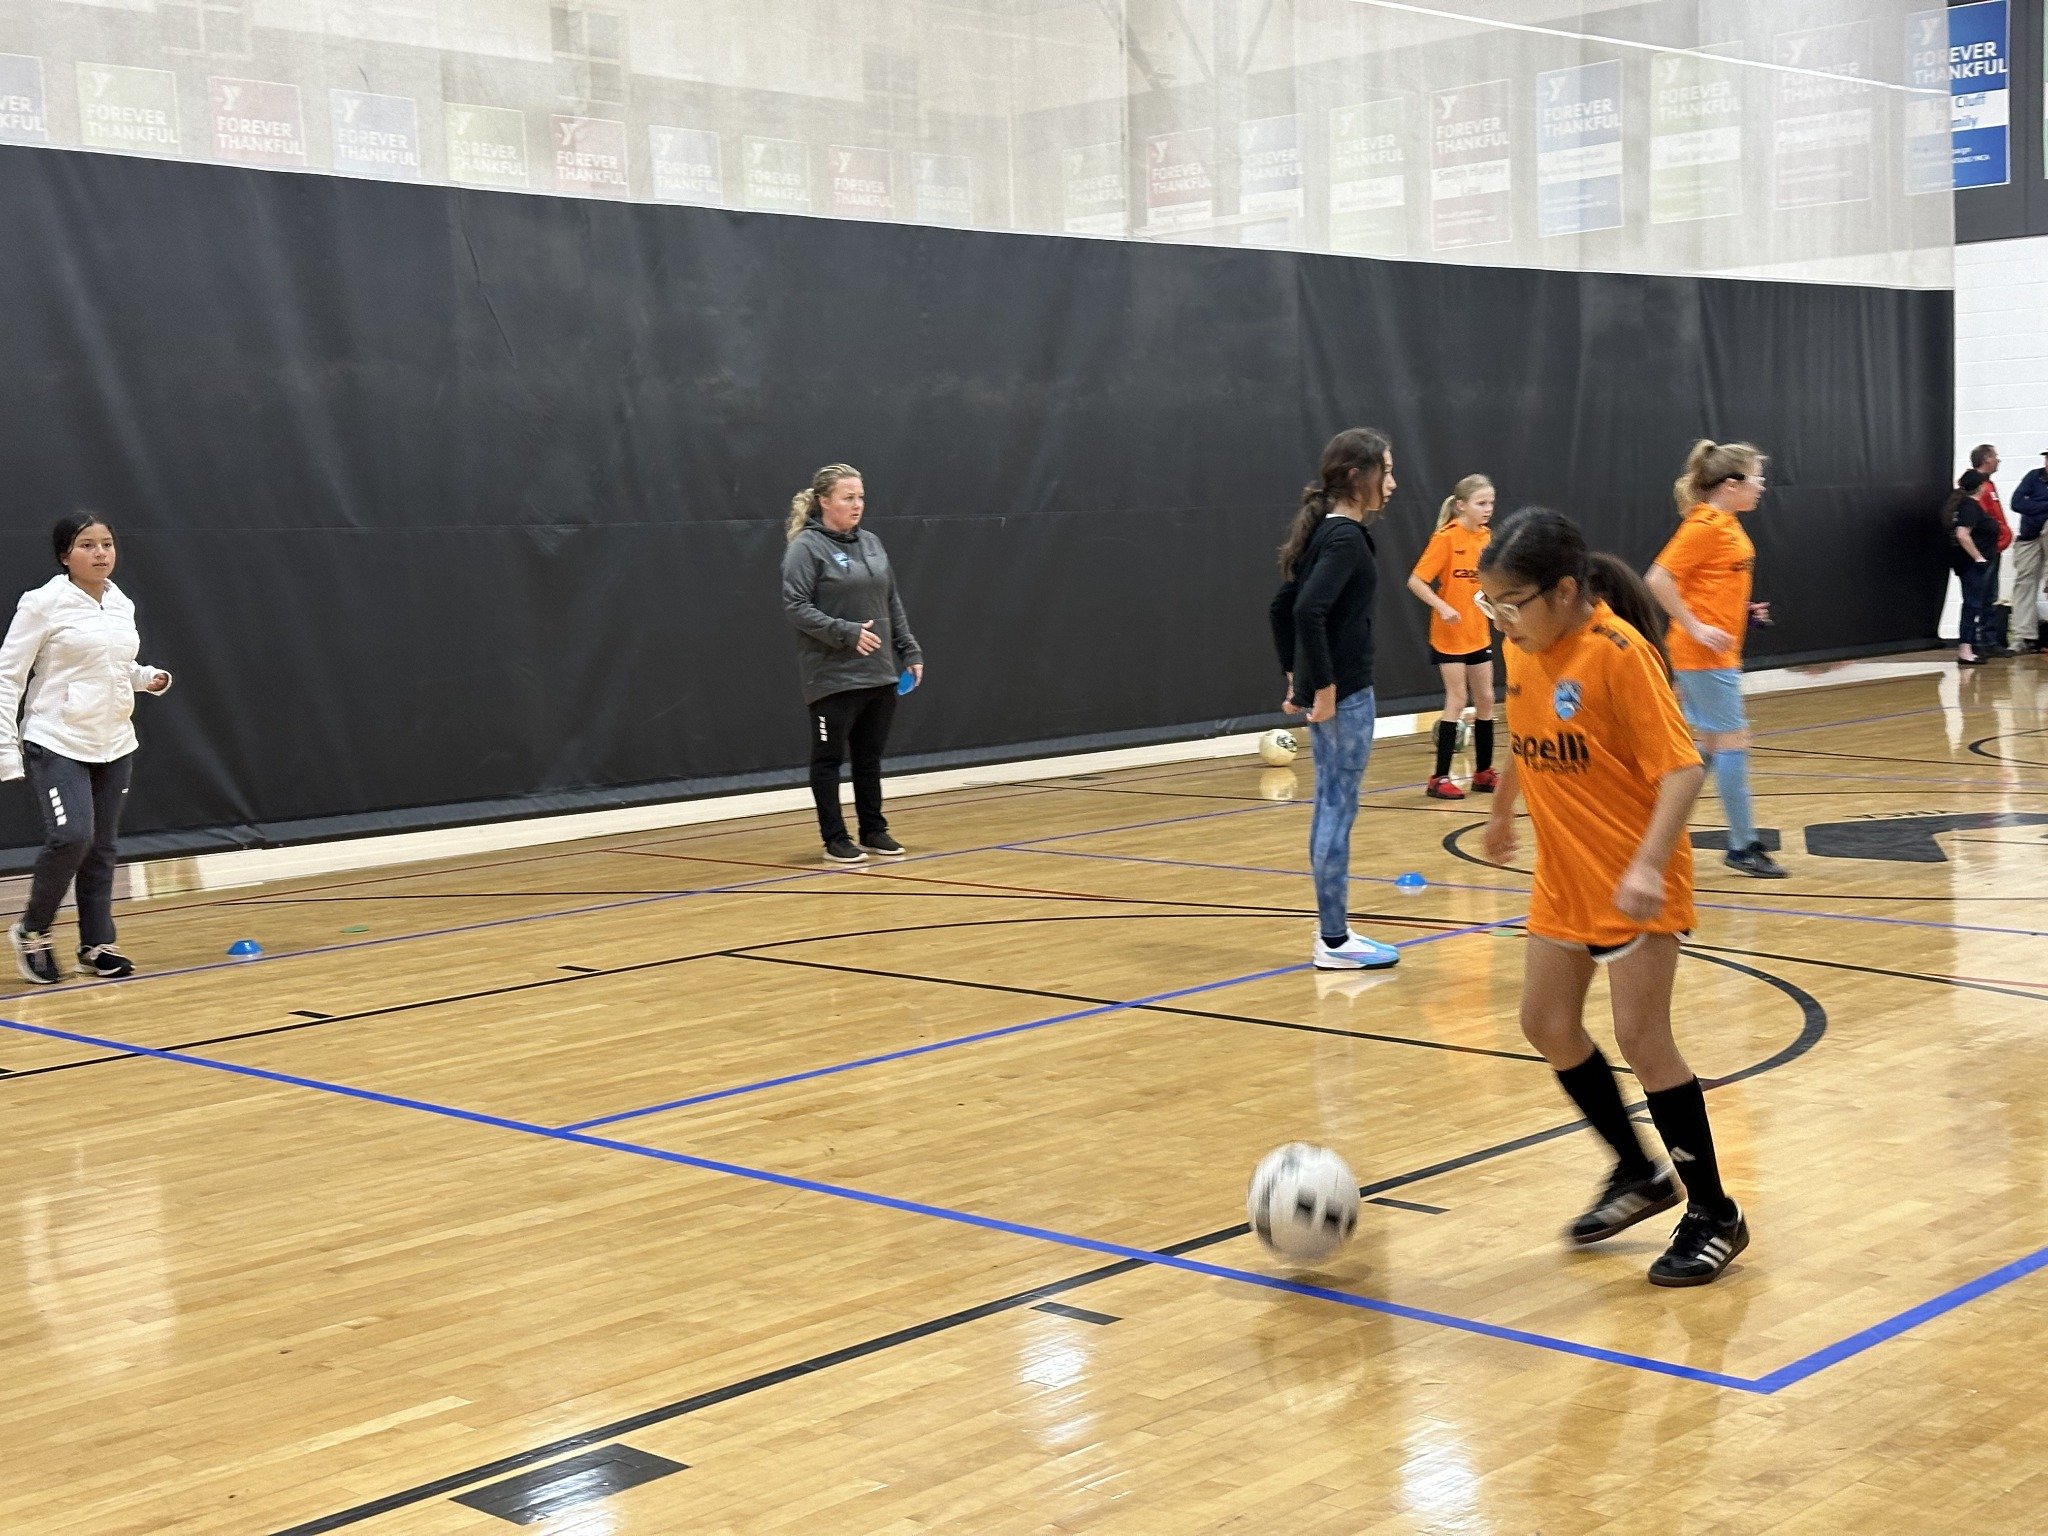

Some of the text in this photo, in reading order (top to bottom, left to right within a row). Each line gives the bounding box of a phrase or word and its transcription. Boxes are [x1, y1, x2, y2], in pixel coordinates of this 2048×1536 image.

[1912, 41, 1997, 67] FOREVER
[1913, 60, 2008, 85] THANKFUL
[1659, 81, 1731, 105] FOREVER
[86, 104, 167, 126] FOREVER
[1543, 98, 1614, 122] FOREVER
[1659, 98, 1741, 121] THANKFUL
[85, 121, 180, 144] THANKFUL
[216, 116, 293, 138] FOREVER
[1436, 116, 1502, 139] FOREVER
[1543, 113, 1622, 137] THANKFUL
[216, 133, 305, 155] THANKFUL
[338, 128, 408, 149] FOREVER
[1335, 133, 1396, 155] FOREVER
[1435, 131, 1510, 154] THANKFUL
[338, 144, 418, 166] THANKFUL
[556, 150, 618, 169] FOREVER
[1335, 148, 1404, 169] THANKFUL
[556, 165, 629, 185] THANKFUL
[1151, 162, 1205, 180] FOREVER
[1151, 176, 1212, 194] THANKFUL
[1511, 730, 1590, 768] apelli
